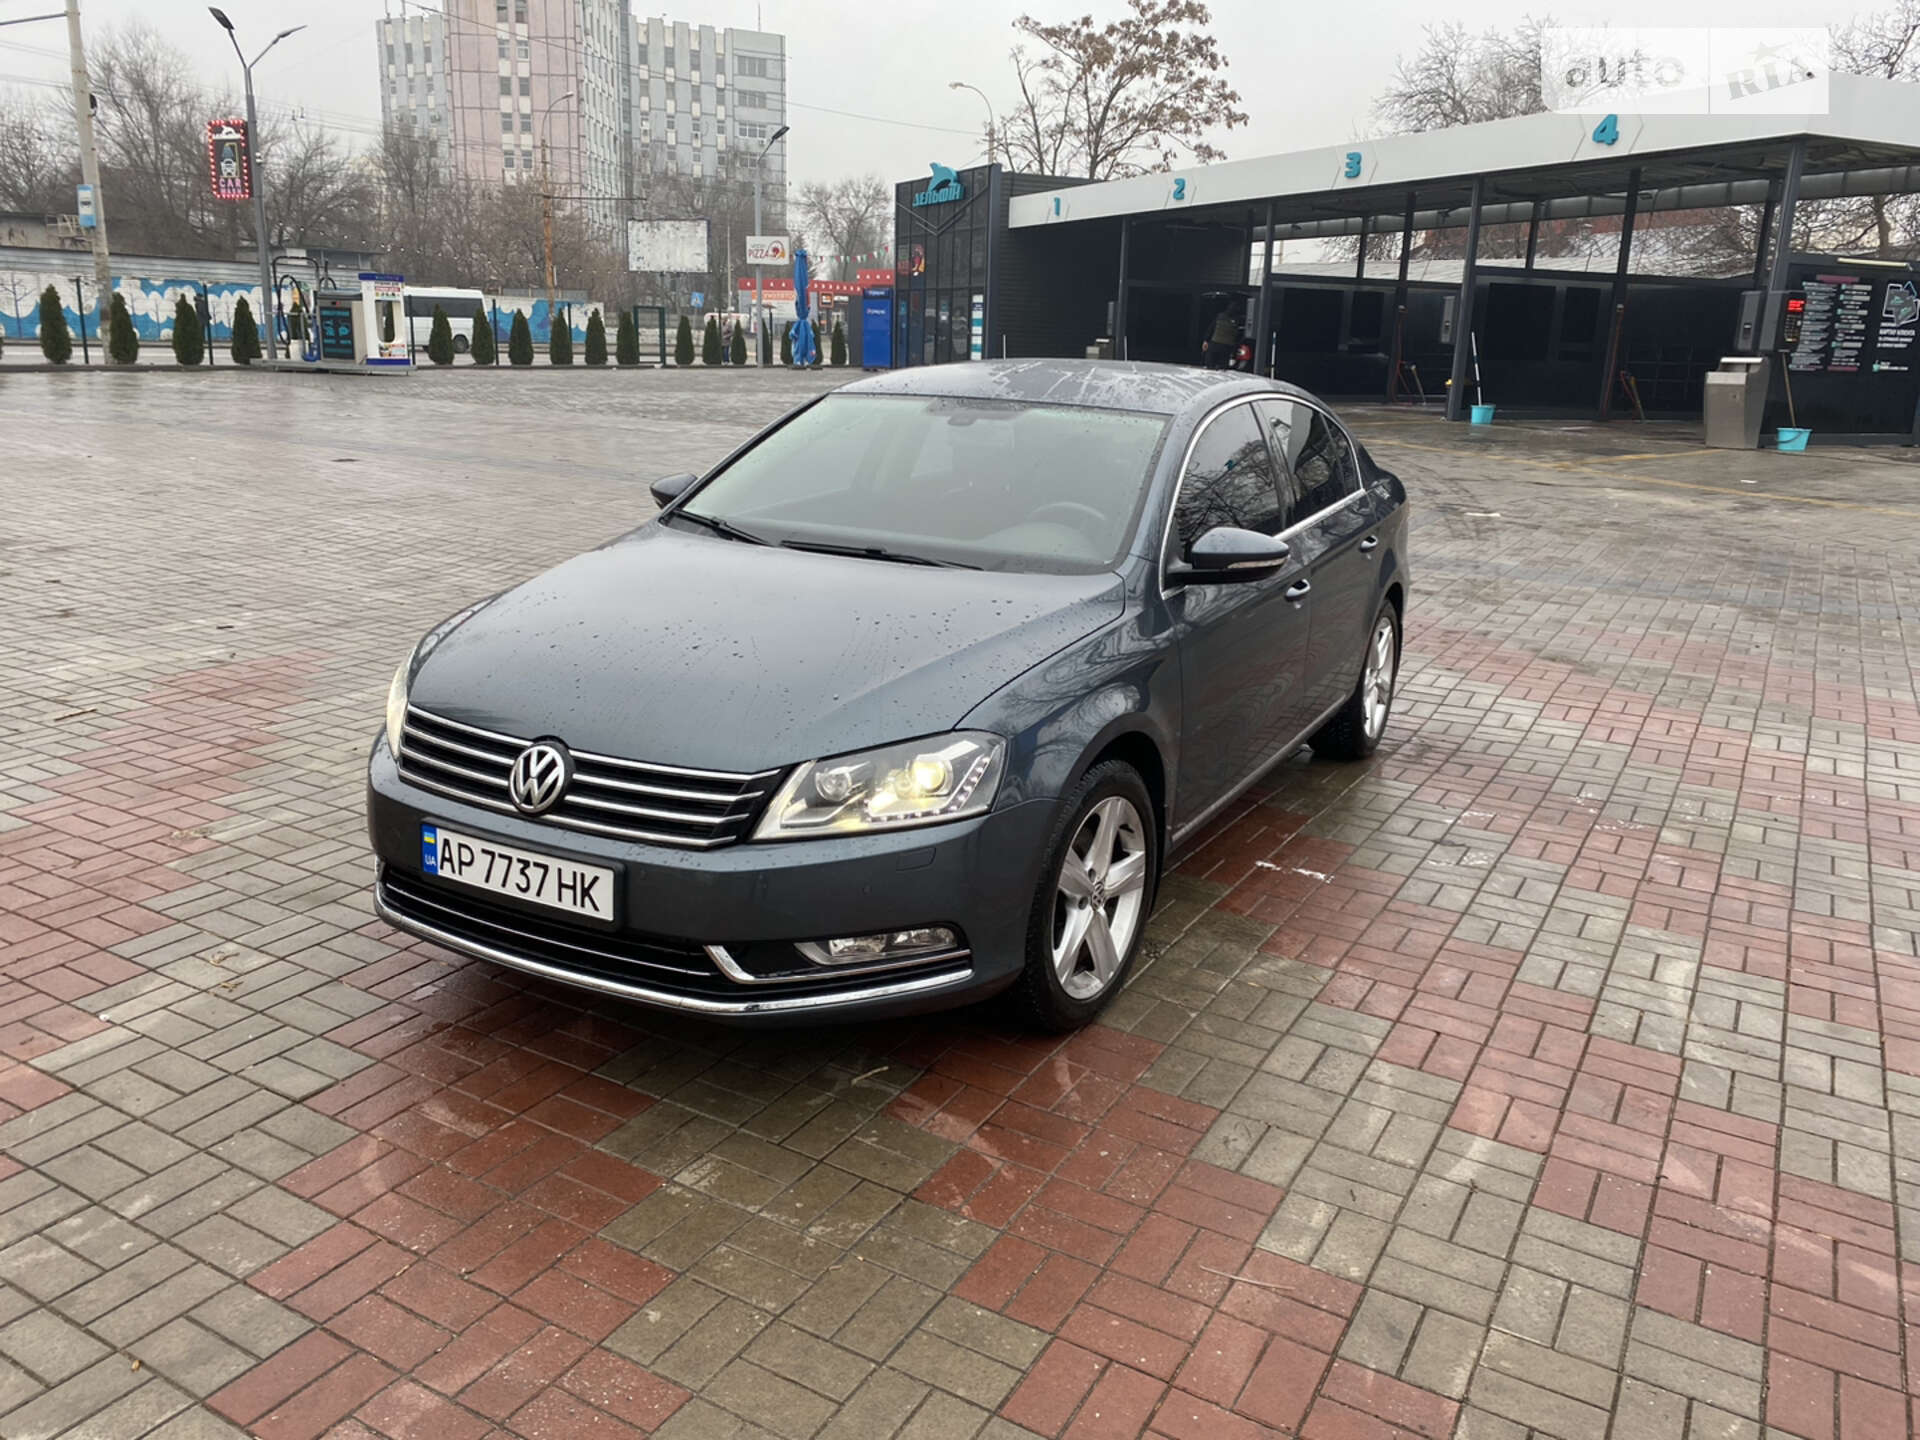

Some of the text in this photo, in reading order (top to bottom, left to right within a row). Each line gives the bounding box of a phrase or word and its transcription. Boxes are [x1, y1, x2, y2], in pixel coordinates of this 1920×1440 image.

[1592, 114, 1619, 146] 4
[1344, 152, 1362, 179] 3
[219, 177, 242, 188] CAR
[1172, 178, 1186, 200] 2
[1053, 197, 1061, 216] 1
[425, 855, 436, 866] UA
[440, 838, 600, 912] AP 7737 HK
